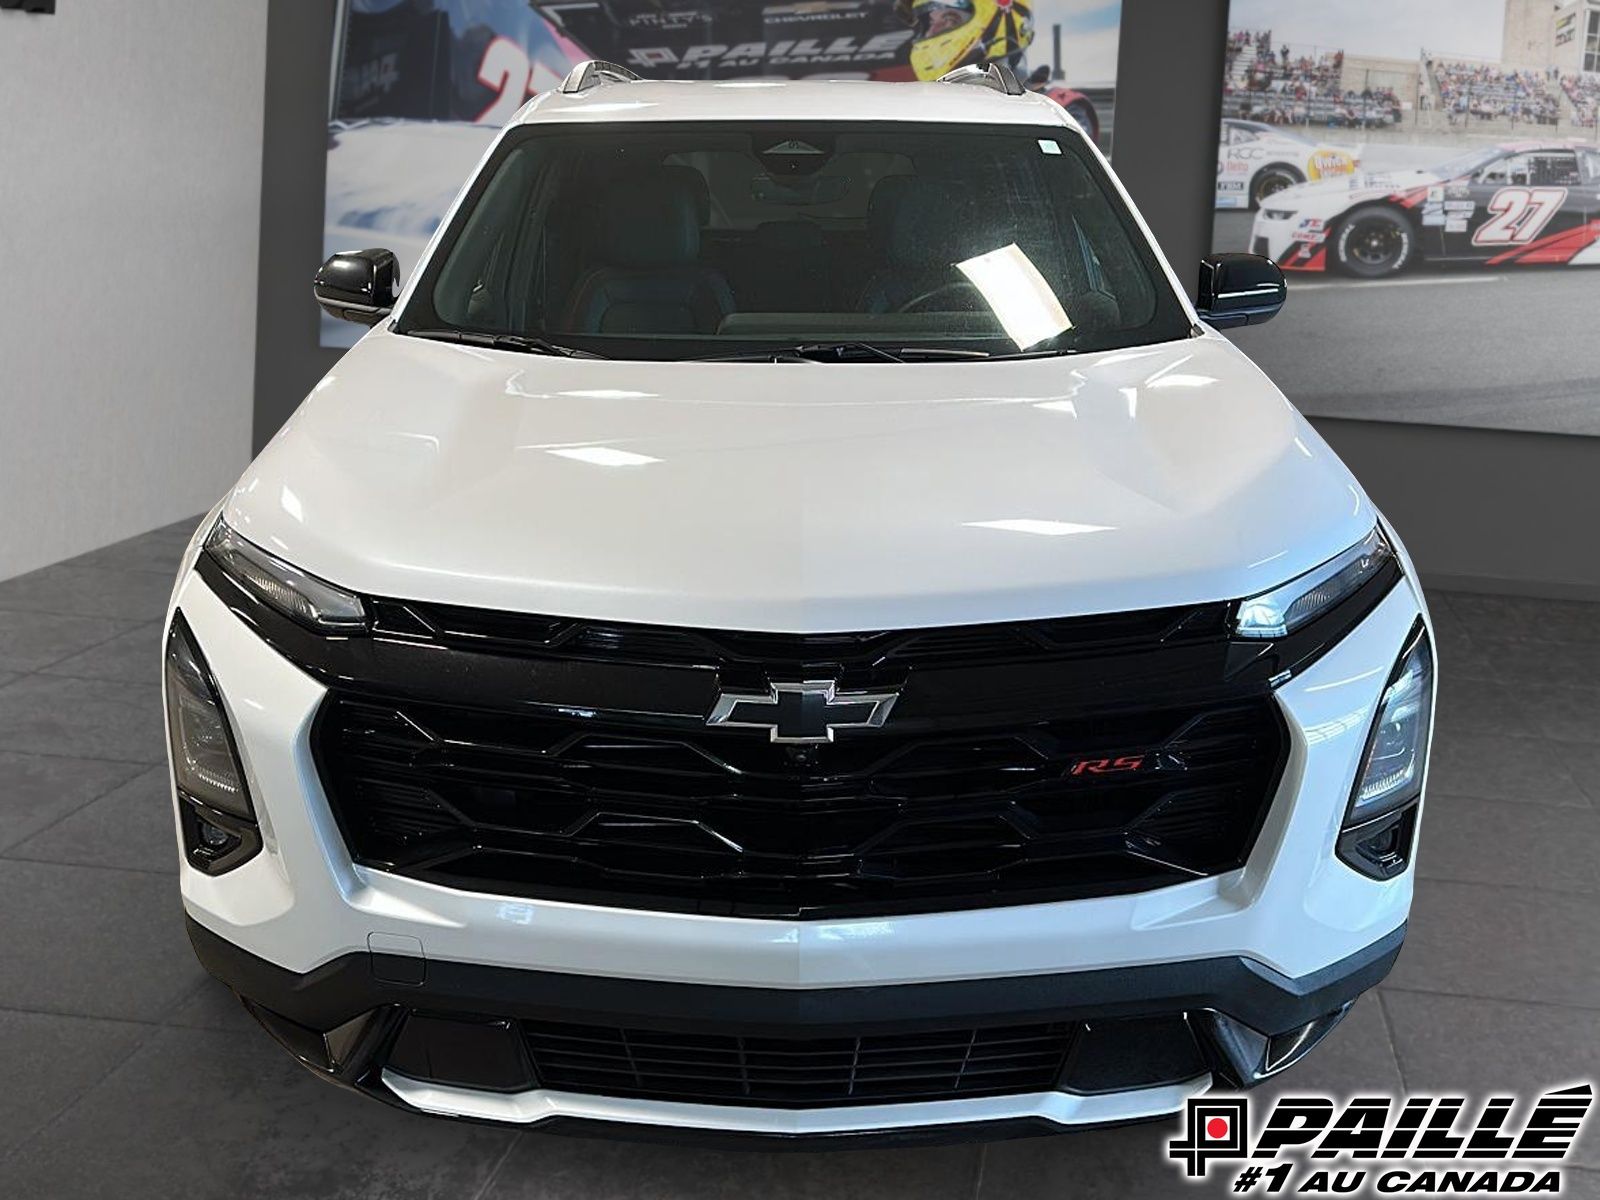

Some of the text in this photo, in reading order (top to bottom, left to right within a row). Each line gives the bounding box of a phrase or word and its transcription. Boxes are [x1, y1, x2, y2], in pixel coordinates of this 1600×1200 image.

[764, 12, 868, 24] CHEVROLET
[769, 52, 896, 65] CANADA
[1472, 187, 1568, 246] 27
[1070, 755, 1144, 775] RS
